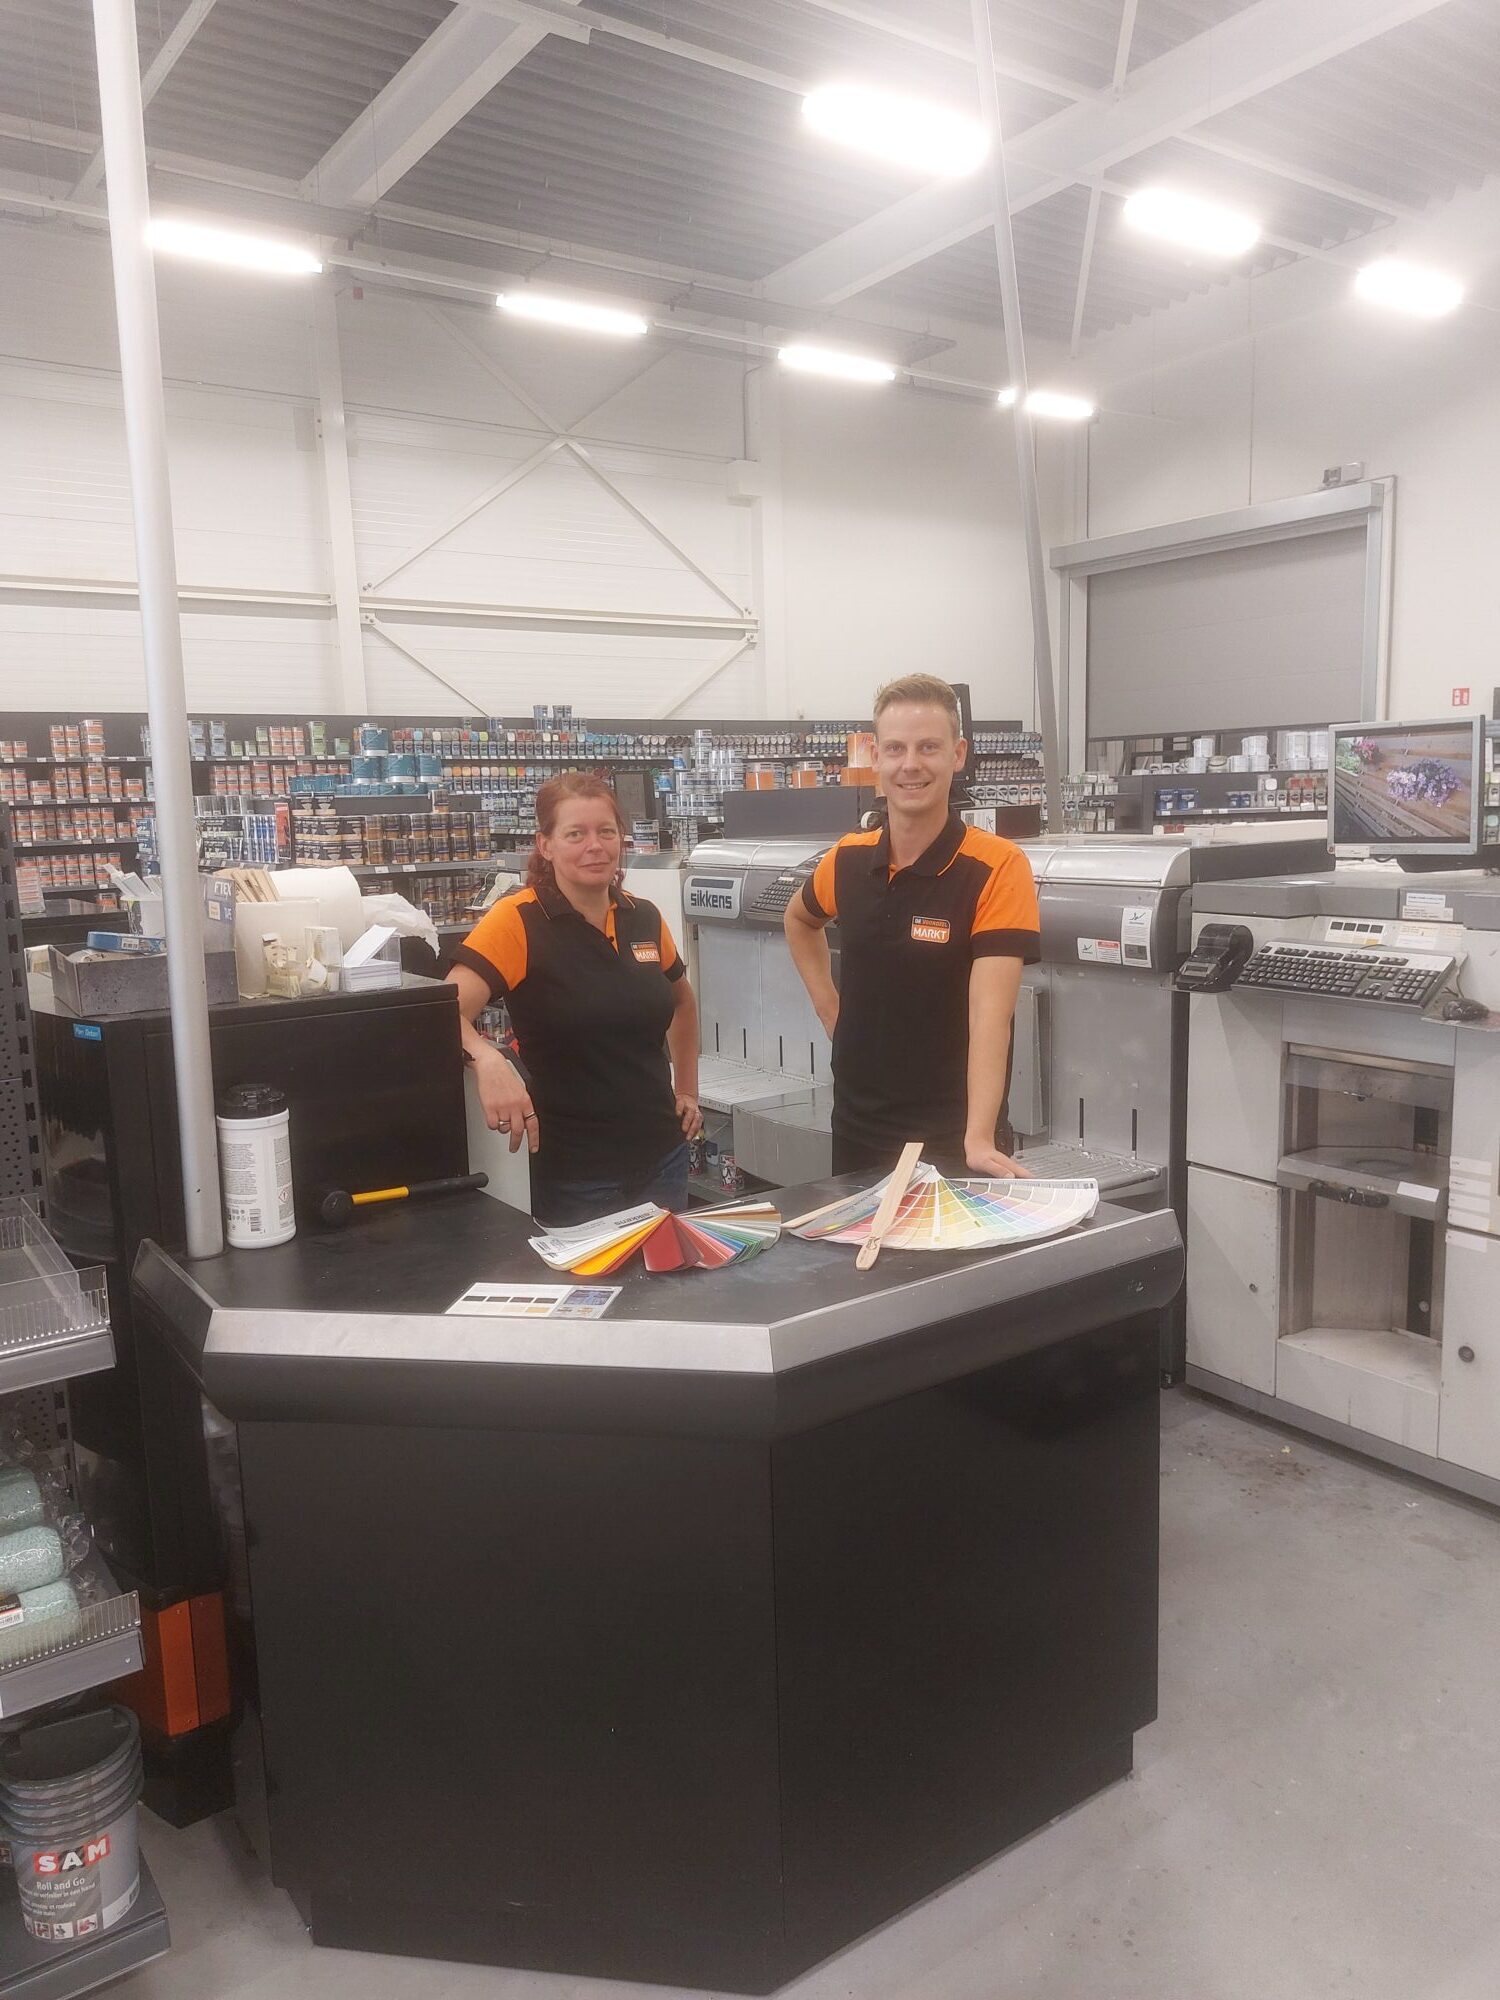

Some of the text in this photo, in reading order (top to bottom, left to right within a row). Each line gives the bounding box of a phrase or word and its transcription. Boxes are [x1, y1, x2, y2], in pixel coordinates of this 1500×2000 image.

[690, 890, 732, 909] sikkens
[913, 927, 947, 940] MARKT
[38, 1838, 107, 1872] SAM
[36, 1881, 52, 1891] Roll
[53, 1879, 71, 1891] and
[72, 1876, 86, 1888] Go
